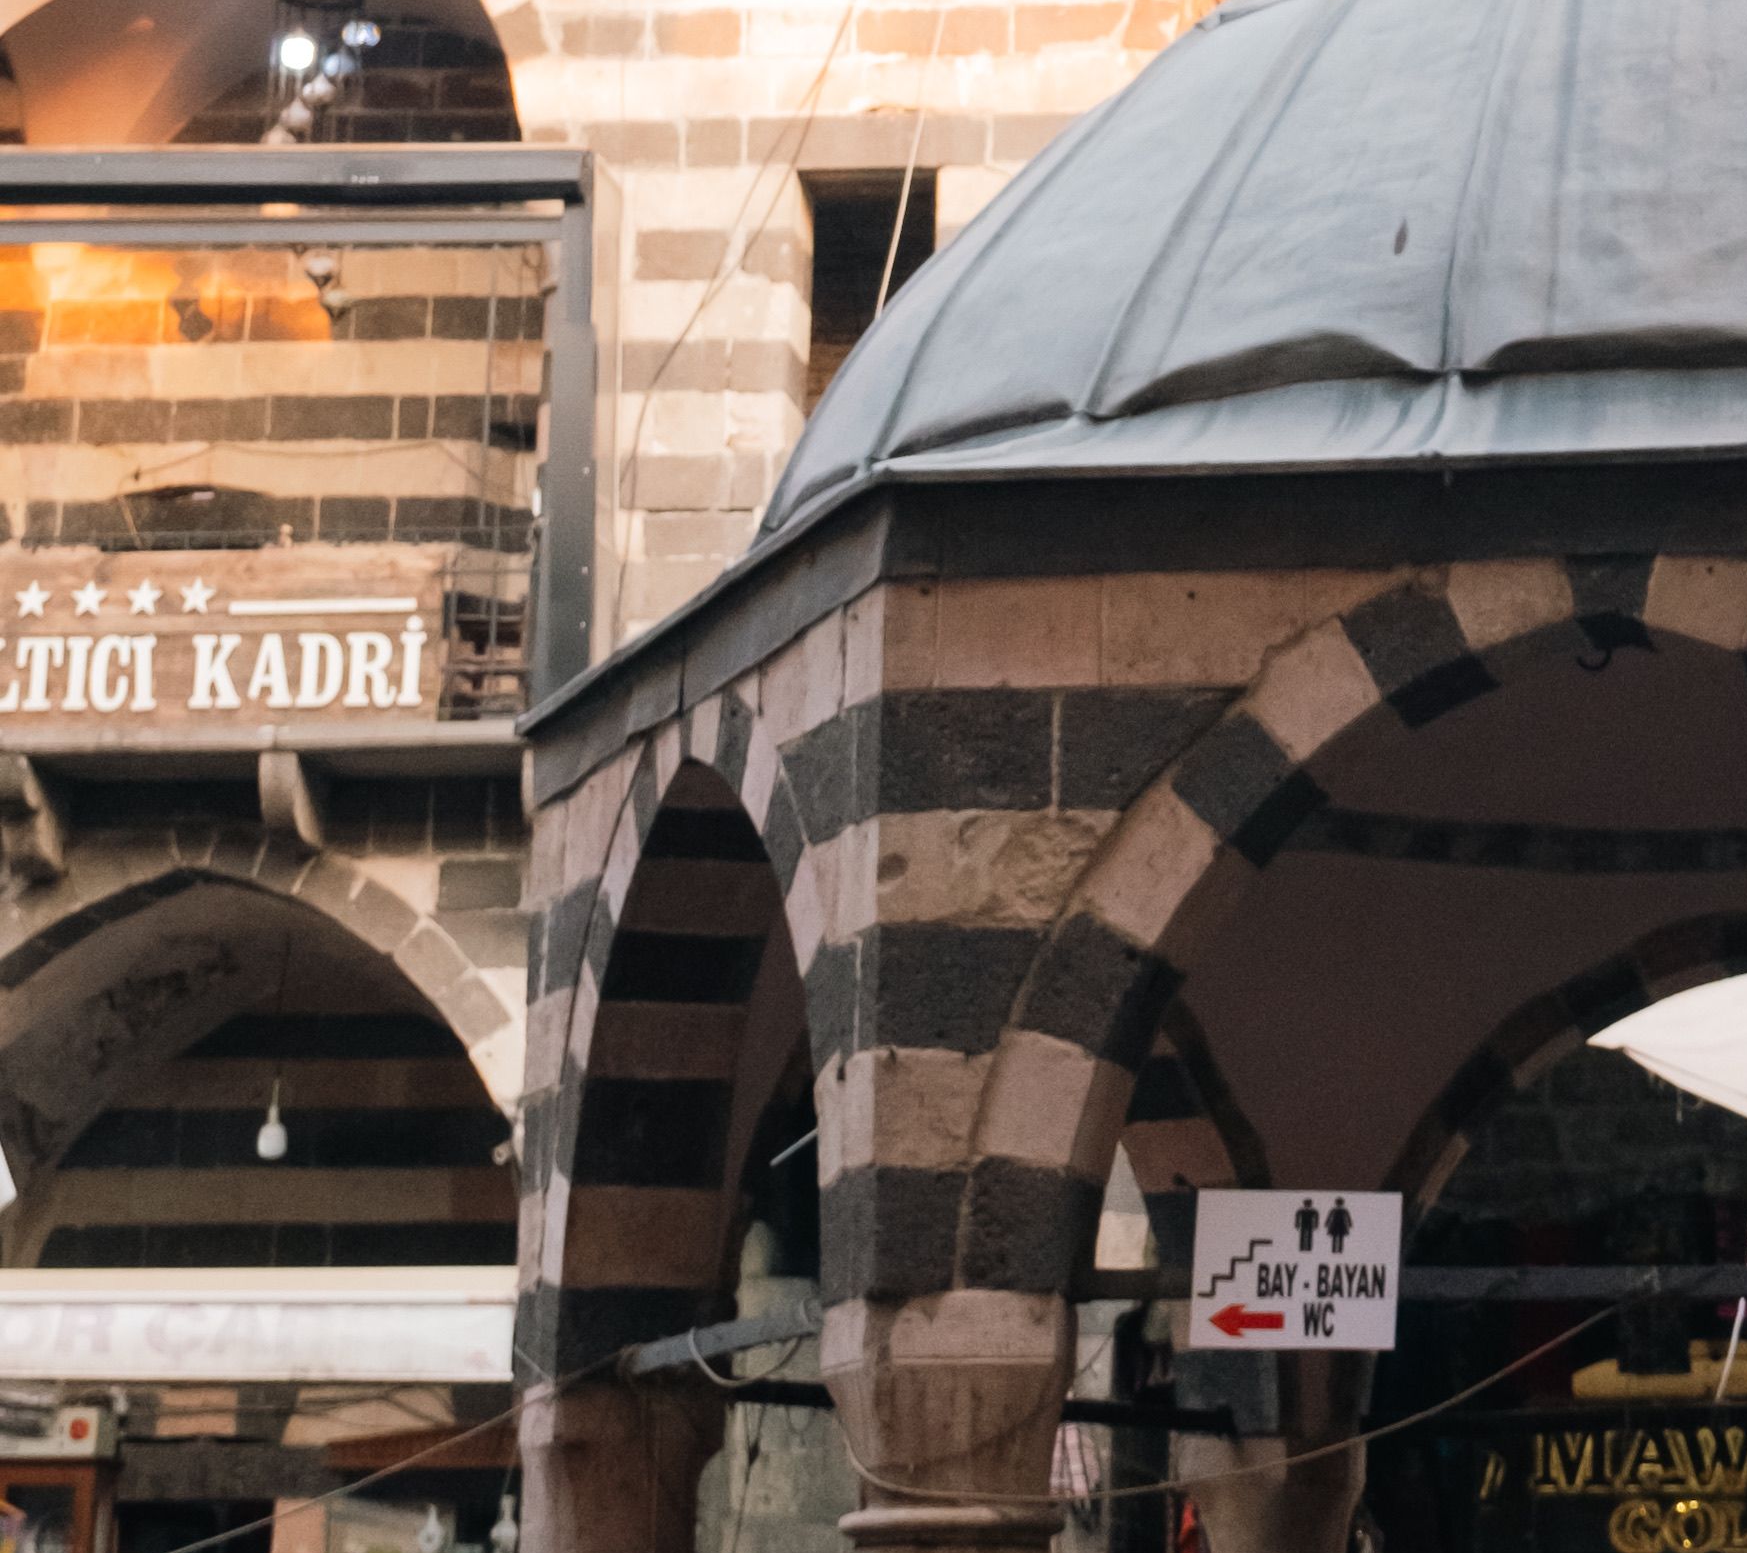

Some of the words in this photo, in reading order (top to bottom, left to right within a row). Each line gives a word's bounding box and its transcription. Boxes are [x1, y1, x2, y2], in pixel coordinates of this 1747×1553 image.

[187, 614, 427, 710] KADRİ
[1256, 1262, 1299, 1298] BAY
[1316, 1263, 1386, 1299] BAYAN
[1303, 1302, 1335, 1338] WC
